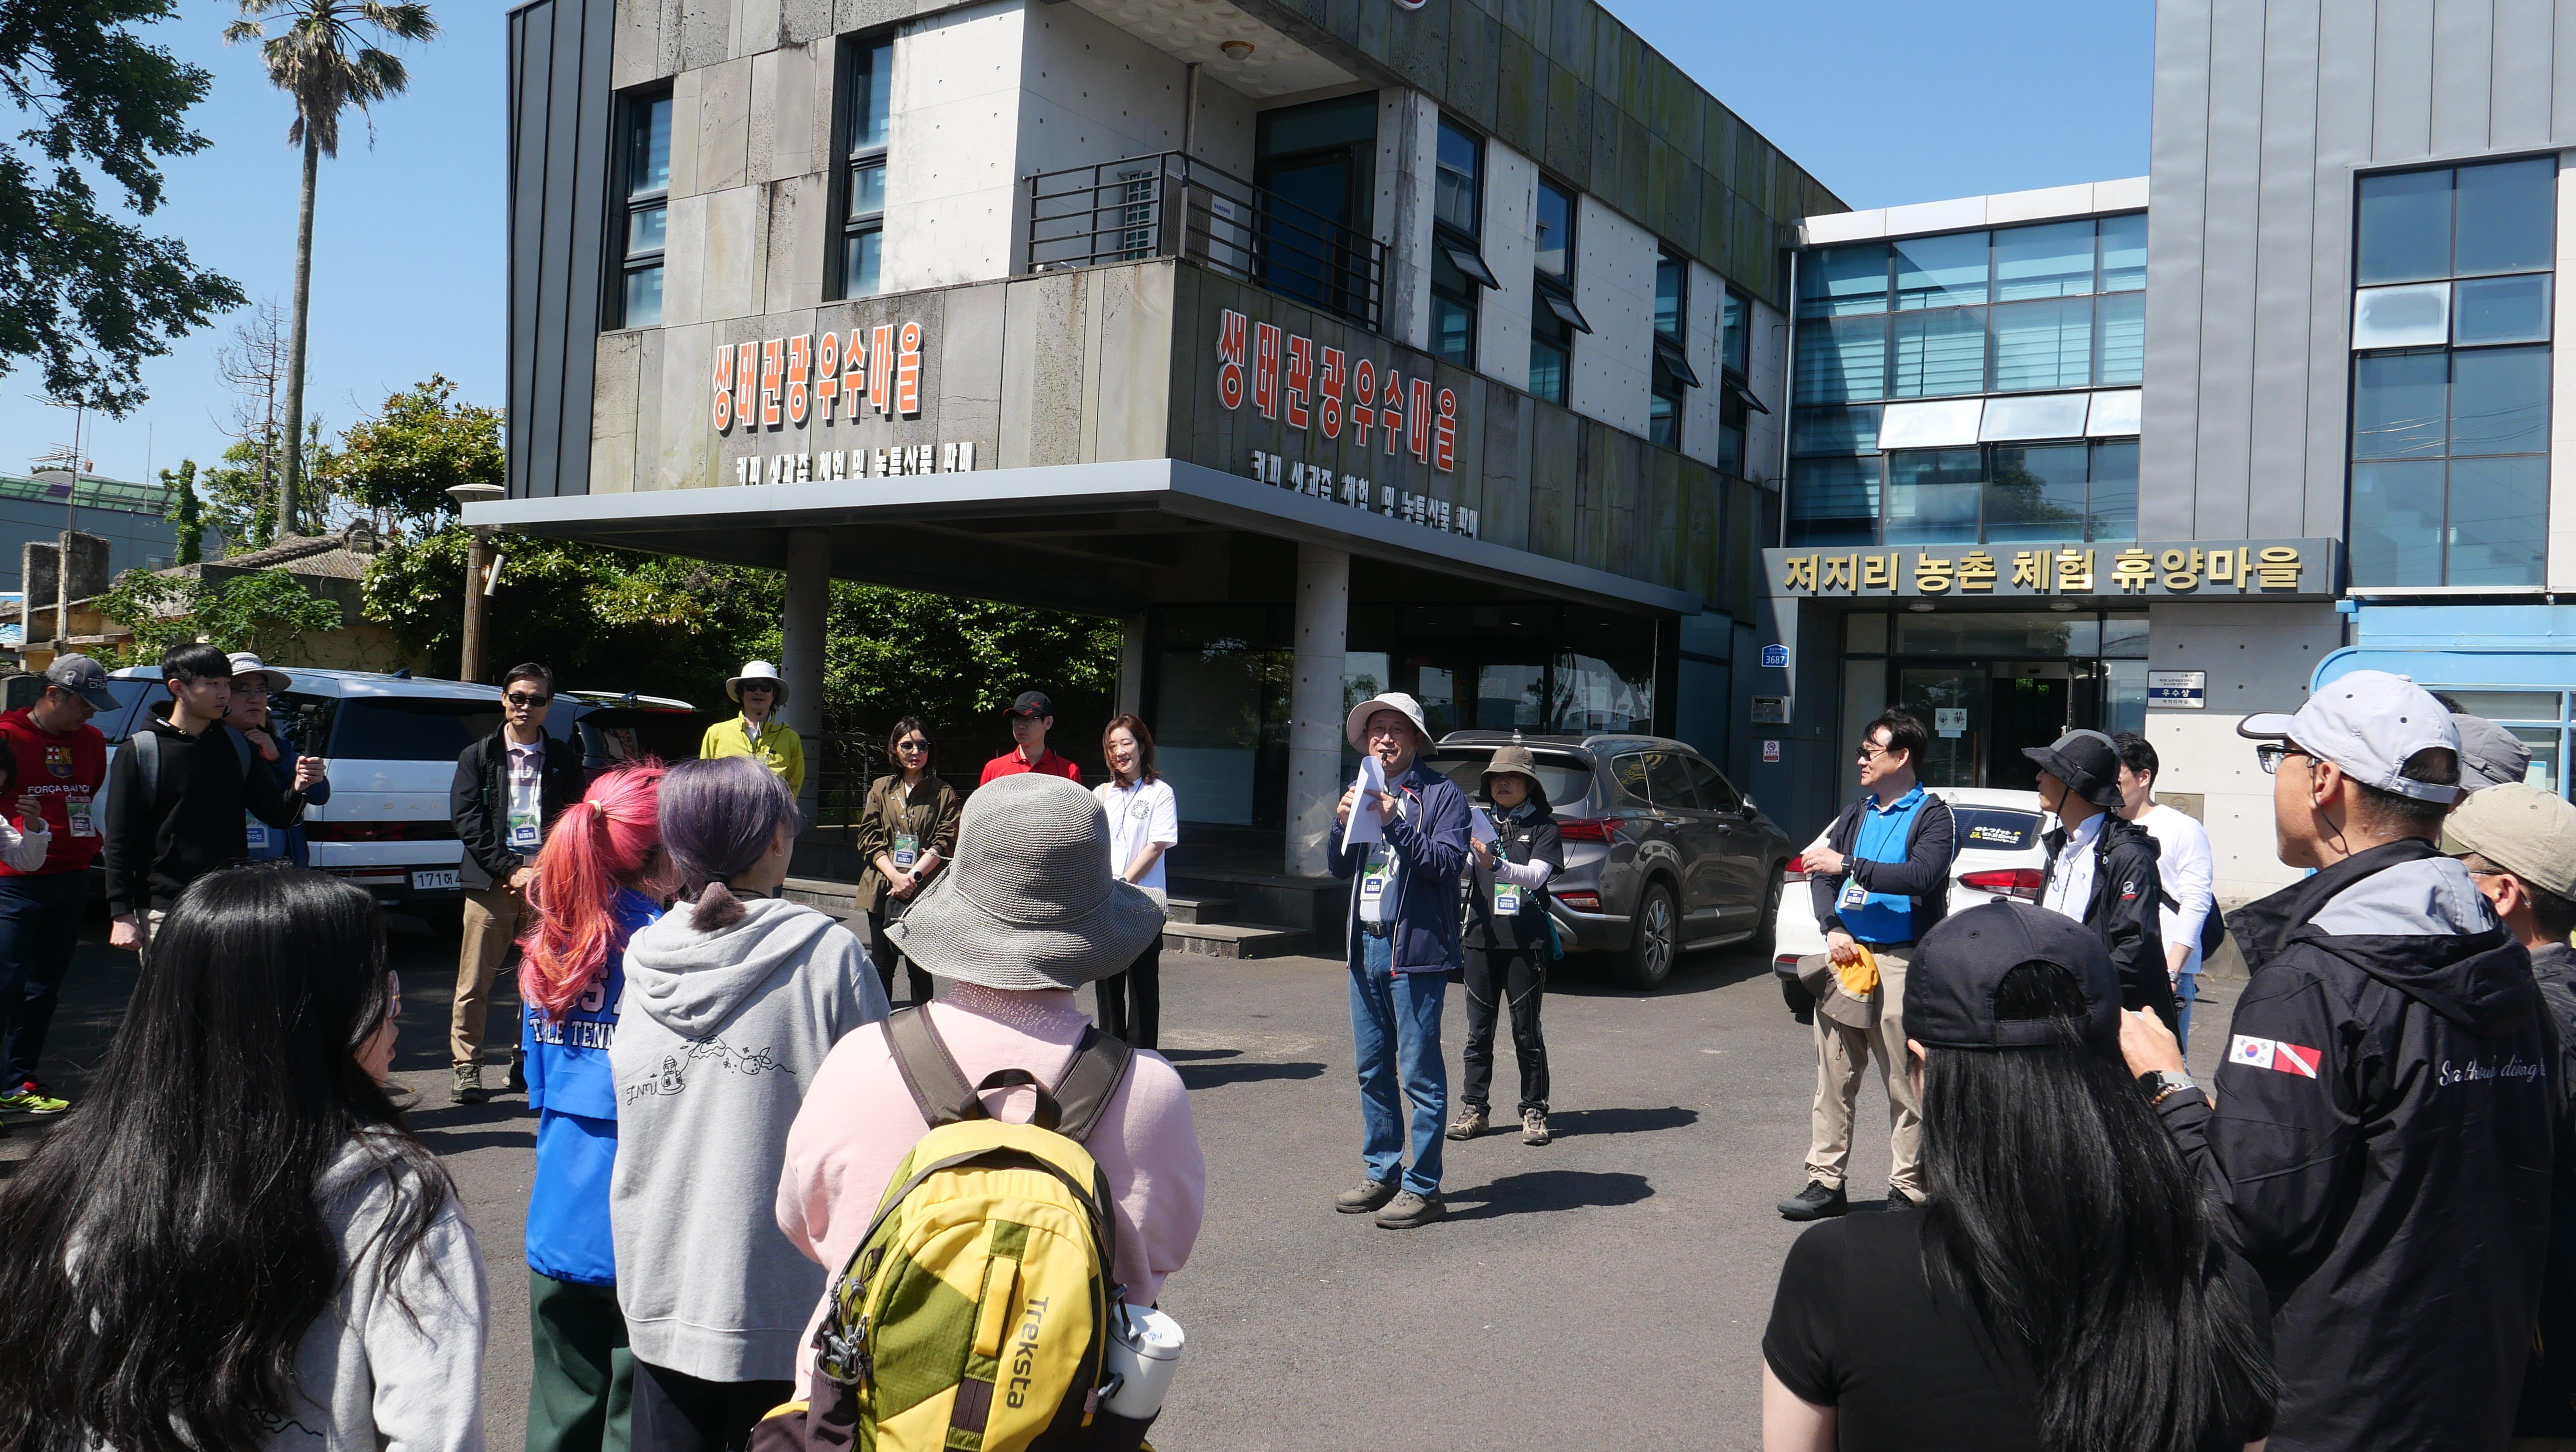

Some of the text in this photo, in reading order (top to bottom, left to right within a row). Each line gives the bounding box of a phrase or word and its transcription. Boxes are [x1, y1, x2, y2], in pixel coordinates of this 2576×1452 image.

[1214, 203, 1230, 214] SAMSUNG
[712, 322, 924, 431] 생태관광우수마을
[1216, 308, 1456, 473] 생태관광우수마을
[736, 442, 976, 486] 커피 생과즙 체험 및 농특산물 판매
[1250, 450, 1282, 488] 커피
[1341, 474, 1369, 512] 체험
[1381, 486, 1394, 517] 및
[1456, 506, 1478, 540] 판매
[1784, 546, 2302, 592] 저지리 농촌 체험 휴양마을
[1766, 656, 1785, 664] 3687
[2162, 689, 2190, 698] 우수상
[28, 785, 62, 794] FORÇA
[1974, 826, 2011, 835] 아기가
[1006, 1296, 1050, 1409] Treksta
